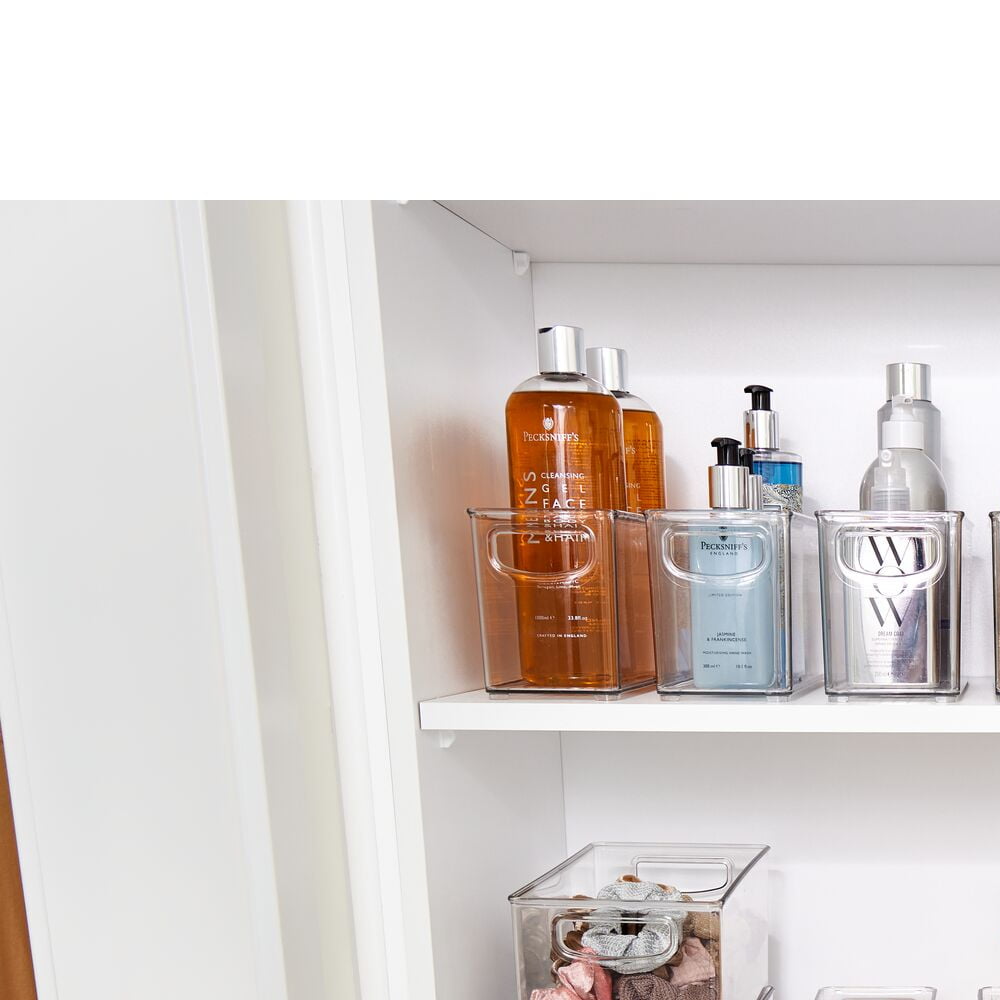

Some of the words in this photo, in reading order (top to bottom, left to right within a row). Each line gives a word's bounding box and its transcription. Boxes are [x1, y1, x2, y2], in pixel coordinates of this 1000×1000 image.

[523, 431, 579, 442] PECKSNIFF'S
[540, 472, 585, 480] CLEANSING
[542, 499, 587, 510] FACE
[701, 541, 748, 550] PECKSNIFF'S
